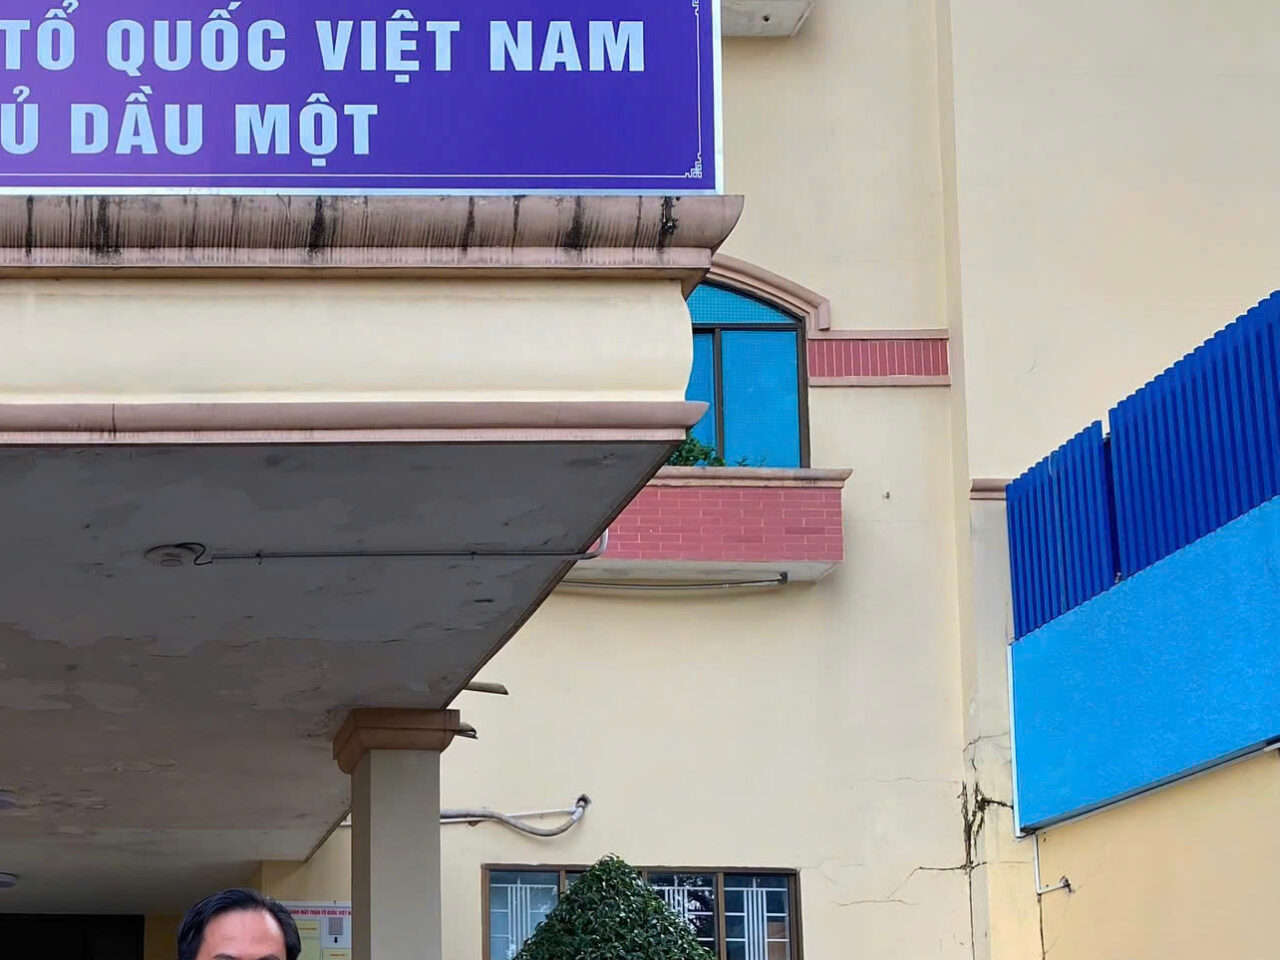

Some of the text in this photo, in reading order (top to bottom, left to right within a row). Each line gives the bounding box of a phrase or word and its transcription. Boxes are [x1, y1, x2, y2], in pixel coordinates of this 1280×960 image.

[107, 2, 285, 76] QUỐC
[316, 10, 460, 82] VIỆT
[490, 20, 645, 72] NAM
[70, 86, 204, 155] DẦU
[235, 93, 379, 167] MỘT
